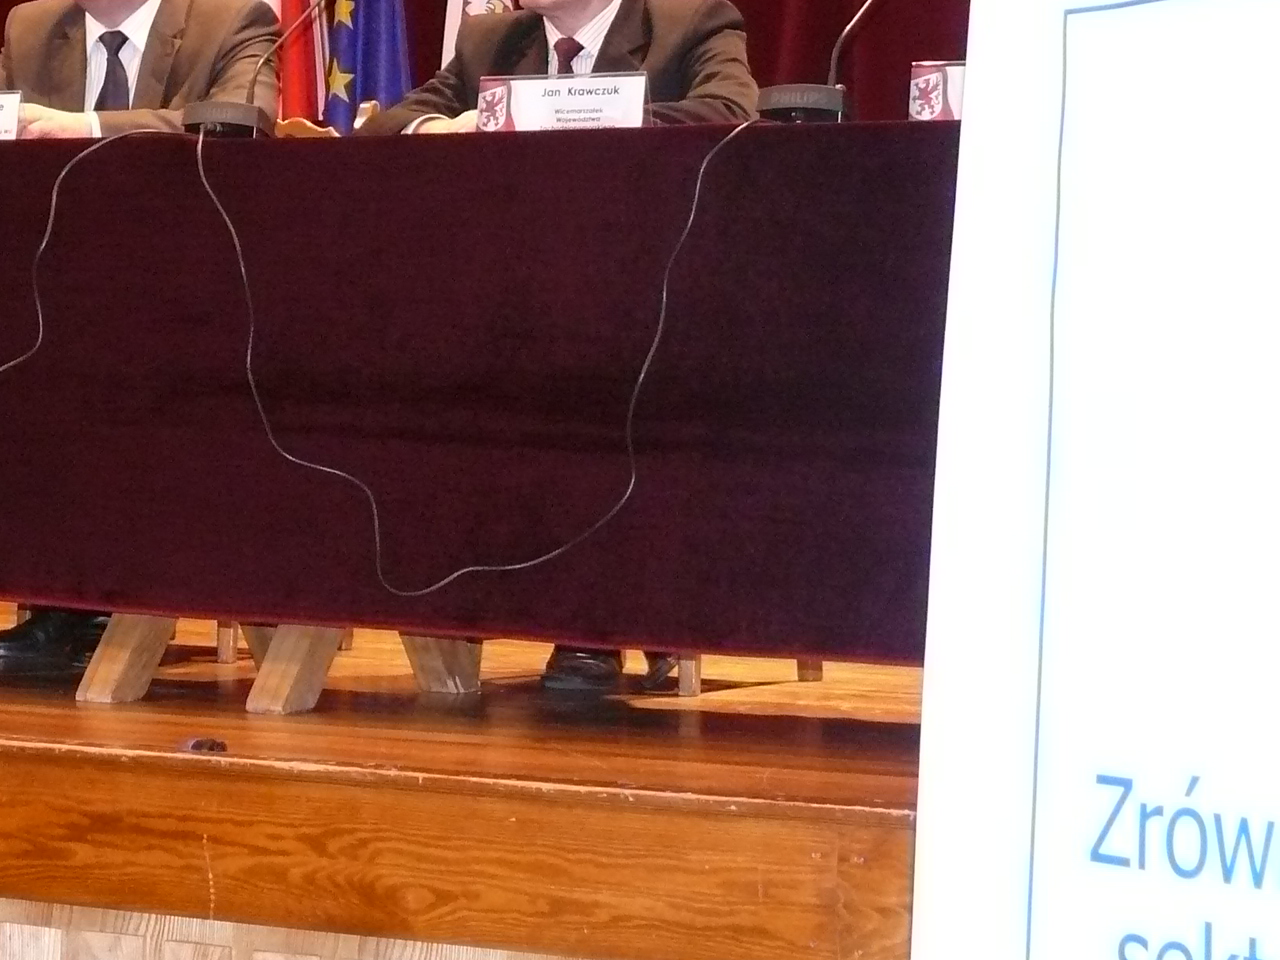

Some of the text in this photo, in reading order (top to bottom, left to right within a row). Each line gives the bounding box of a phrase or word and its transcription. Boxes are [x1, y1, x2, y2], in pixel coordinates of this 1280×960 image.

[541, 85, 620, 97] Jan Krawczuk
[1090, 773, 1275, 890] Zrów
